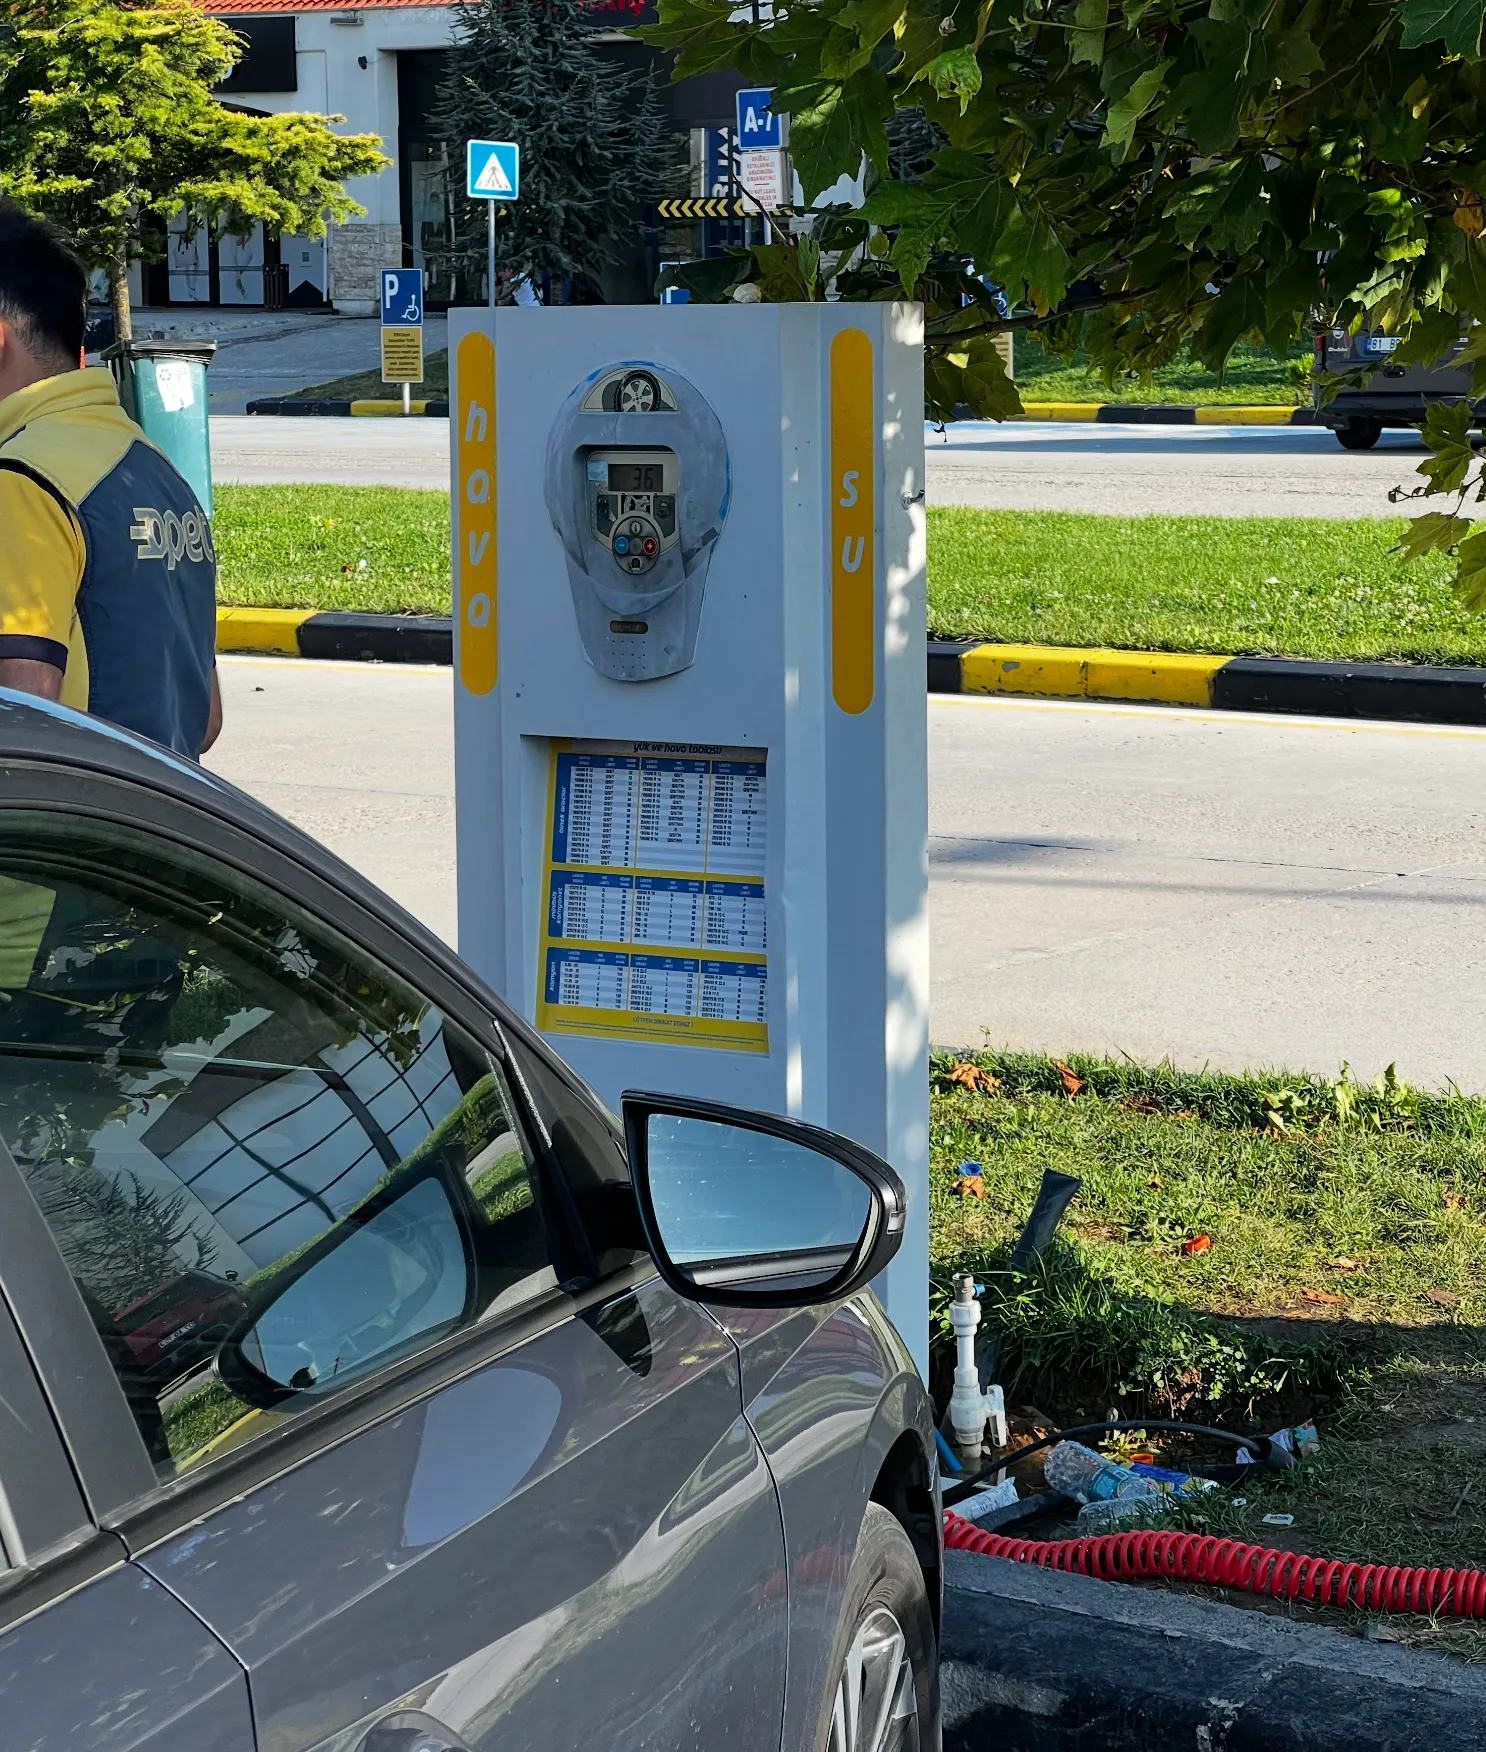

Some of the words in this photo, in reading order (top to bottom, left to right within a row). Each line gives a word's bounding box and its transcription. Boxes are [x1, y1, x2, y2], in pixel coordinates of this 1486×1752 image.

[385, 274, 399, 309] P
[1372, 339, 1382, 349] 81
[633, 467, 654, 490] 36
[464, 399, 490, 628] hava
[839, 471, 864, 573] su
[633, 742, 650, 753] yük
[652, 744, 662, 752] ve
[664, 743, 686, 753] hava
[689, 743, 722, 755] tablosu
